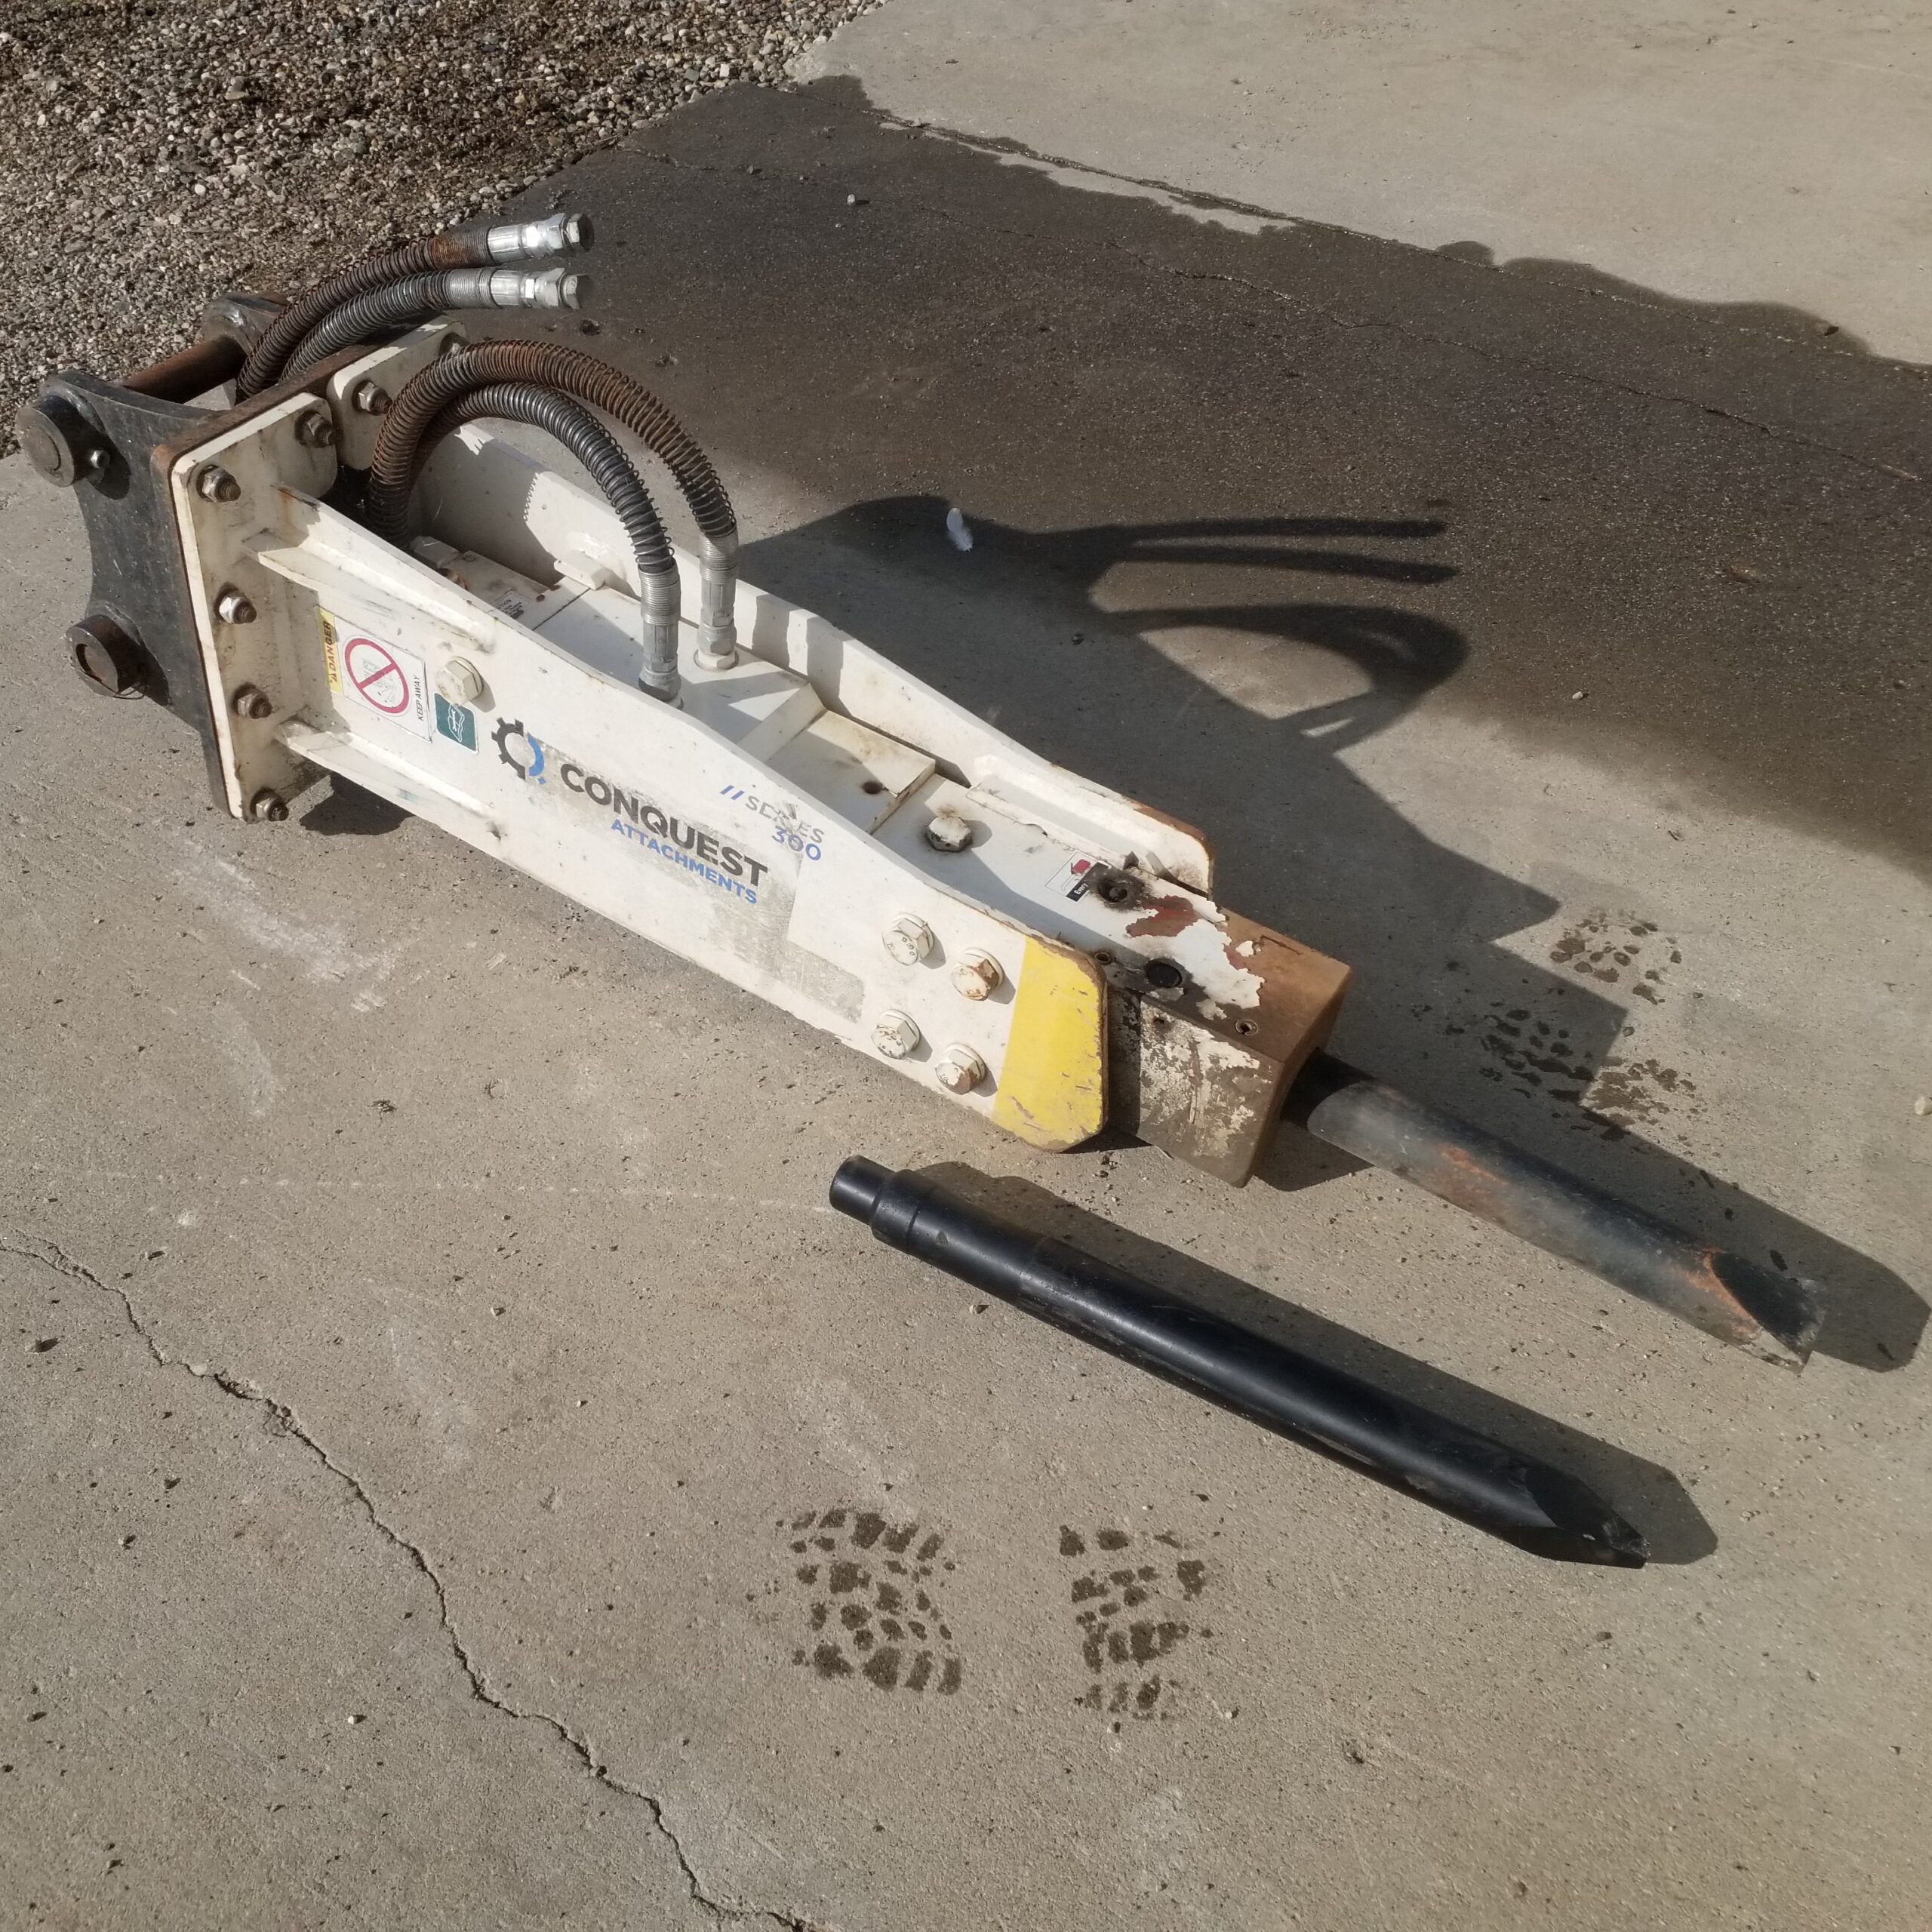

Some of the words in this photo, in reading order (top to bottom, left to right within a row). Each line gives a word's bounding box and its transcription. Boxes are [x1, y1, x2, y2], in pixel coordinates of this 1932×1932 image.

[323, 620, 337, 672] DANGER
[413, 674, 422, 700] AWAY
[560, 764, 768, 887] CONQUEST
[771, 825, 821, 861] 300
[611, 819, 757, 904] ATTACHMENTS
